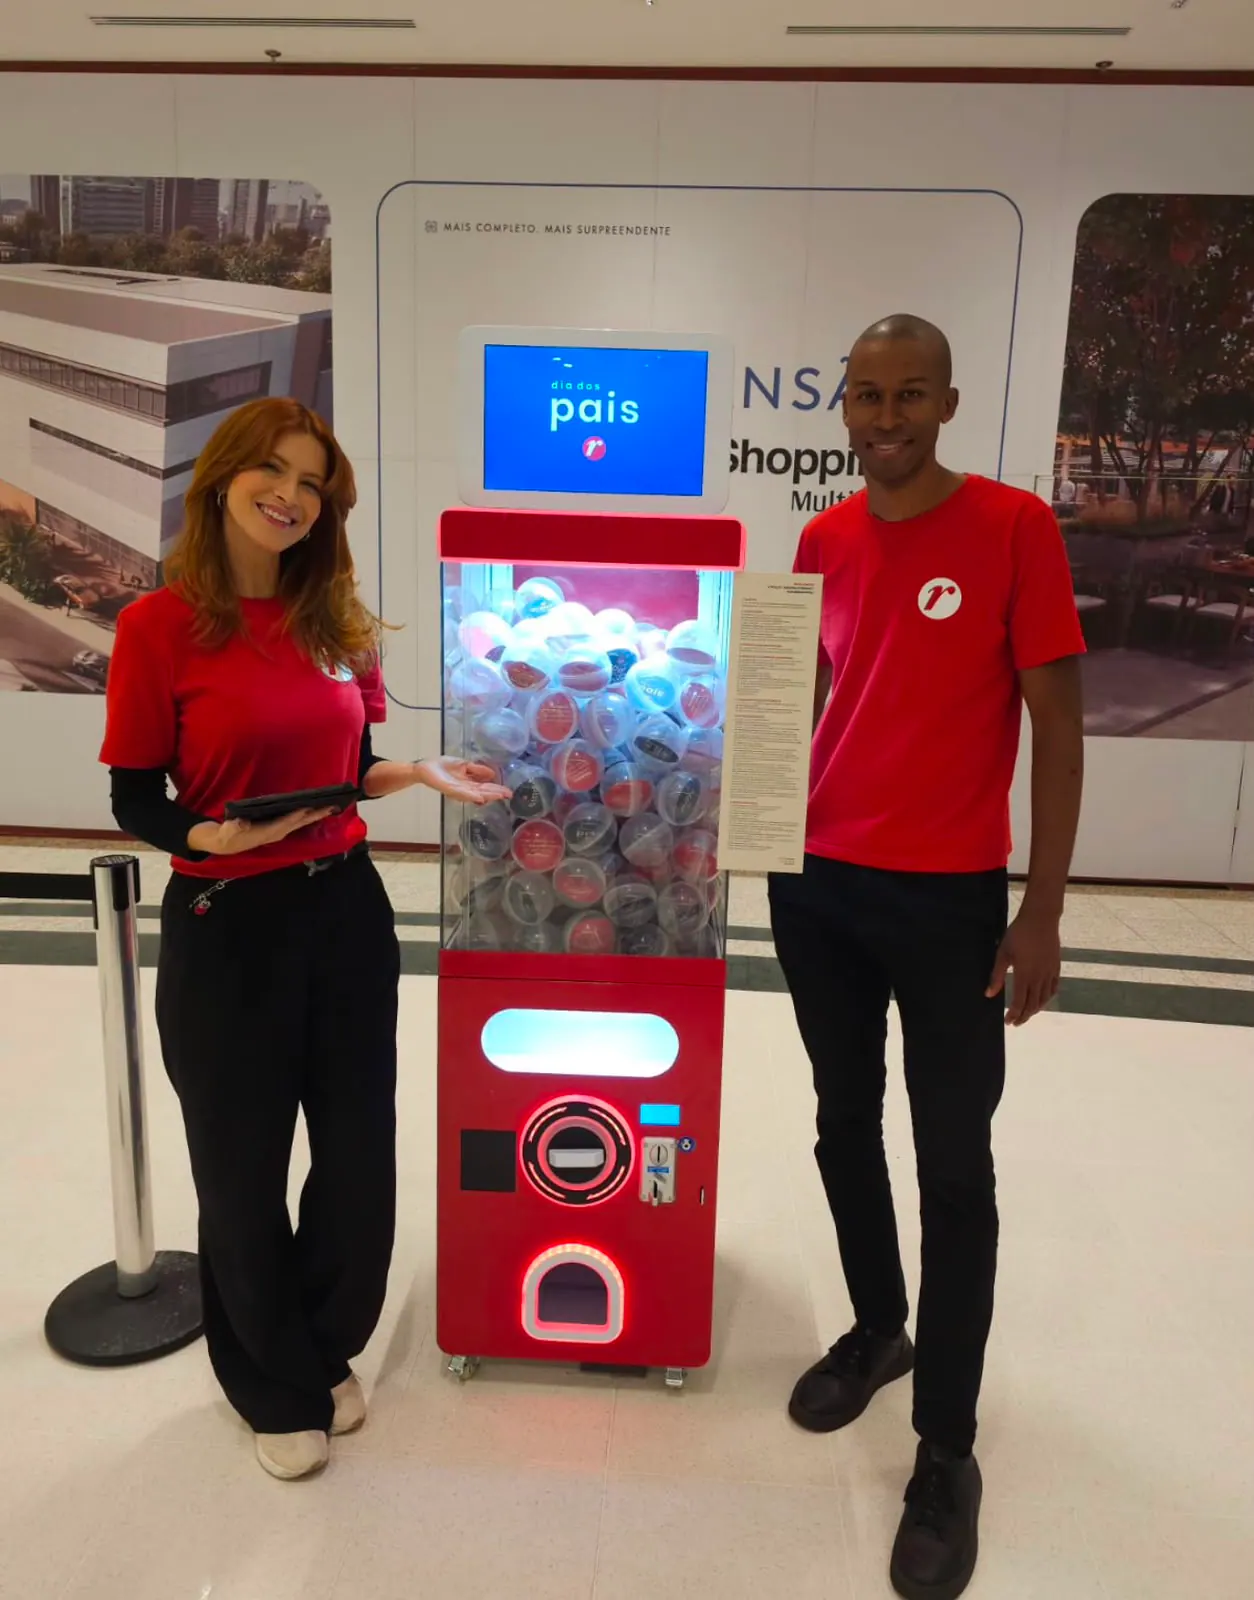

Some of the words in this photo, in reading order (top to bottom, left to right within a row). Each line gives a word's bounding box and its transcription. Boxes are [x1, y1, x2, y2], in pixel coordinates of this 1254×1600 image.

[443, 222, 472, 232] MAIS
[544, 224, 573, 234] MAIS
[576, 224, 671, 236] SURPREENDENTE
[551, 380, 573, 390] dia
[577, 381, 601, 391] dos
[550, 391, 640, 432] pais
[791, 490, 853, 512] Mult
[923, 585, 956, 611] r
